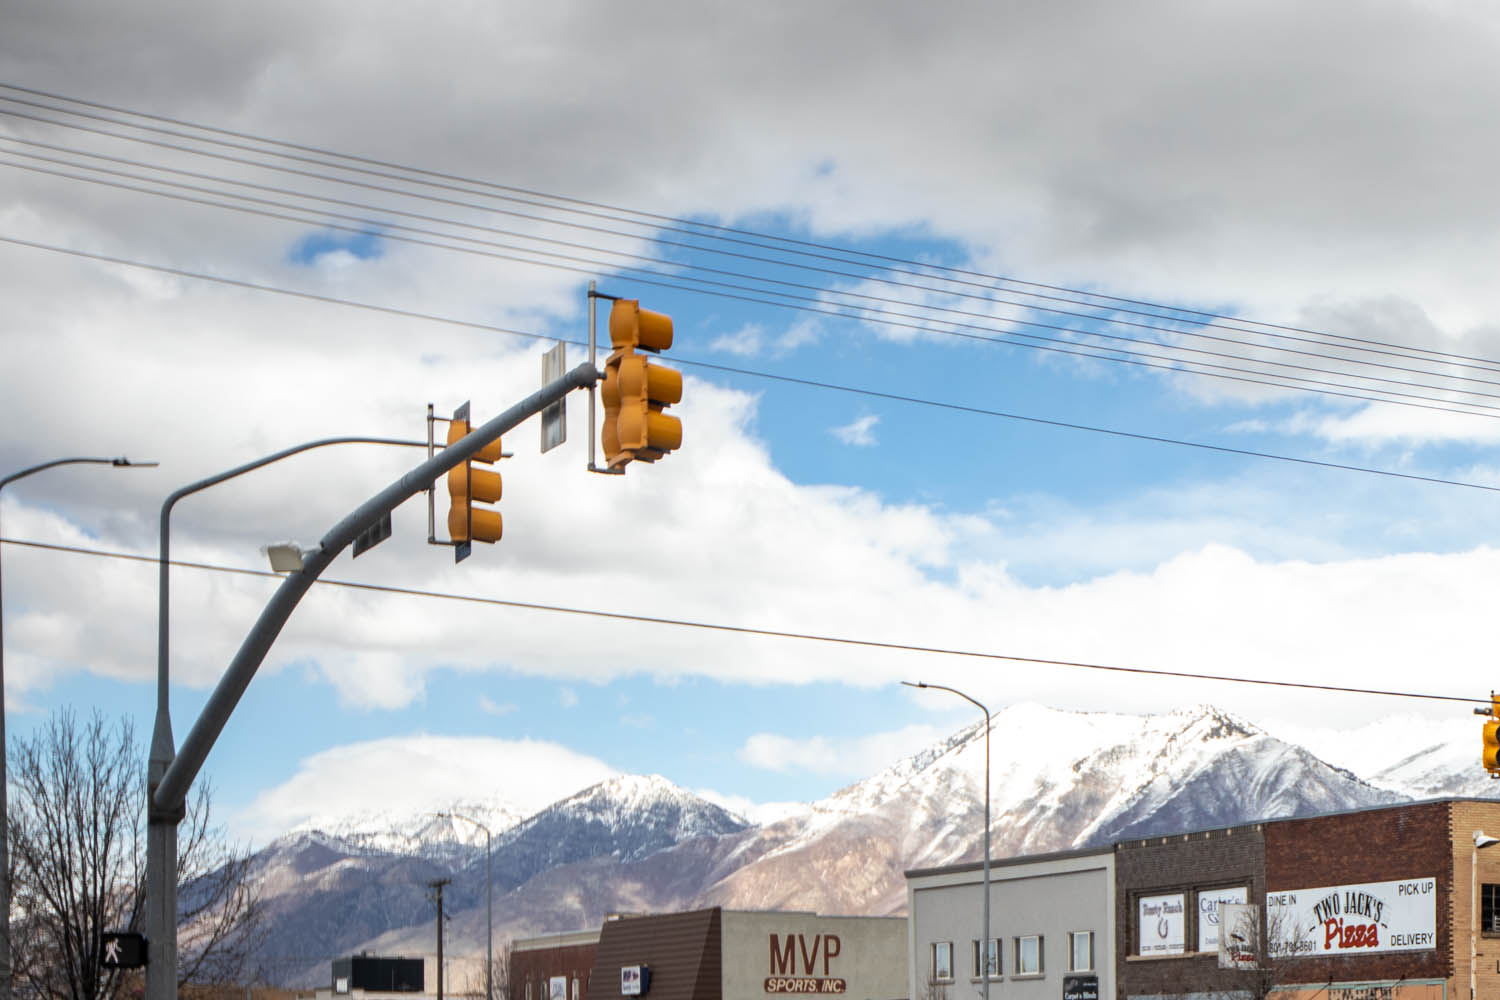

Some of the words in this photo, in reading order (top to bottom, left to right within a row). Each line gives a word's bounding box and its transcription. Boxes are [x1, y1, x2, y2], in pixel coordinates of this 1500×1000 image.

[1268, 894, 1287, 907] DINE
[1288, 894, 1297, 905] IN
[1398, 884, 1419, 897] PICK
[1421, 882, 1433, 894] UP
[1313, 893, 1340, 925] TWO
[1344, 891, 1384, 923] JACK'S
[1323, 917, 1379, 950] Pizza
[1391, 932, 1433, 946] DELIVERY
[769, 933, 841, 976] MVP
